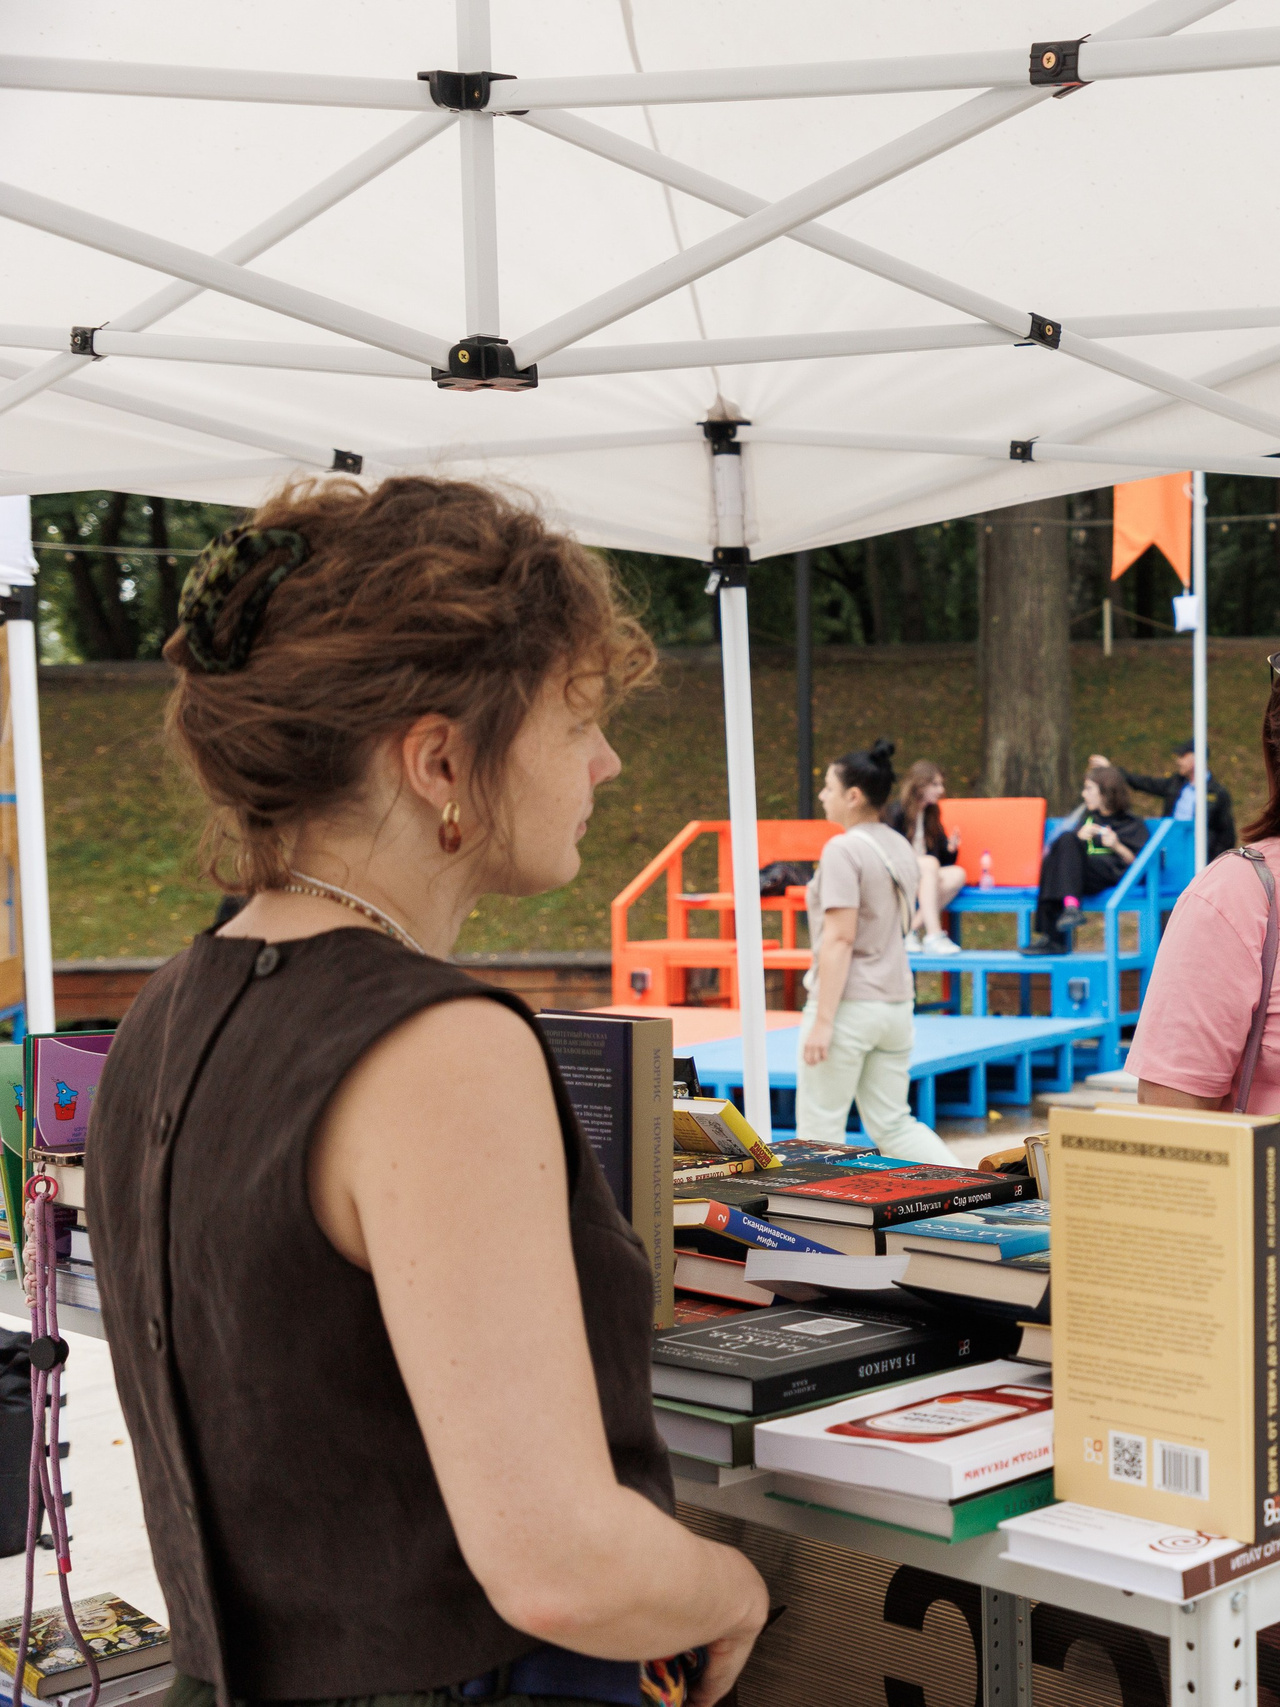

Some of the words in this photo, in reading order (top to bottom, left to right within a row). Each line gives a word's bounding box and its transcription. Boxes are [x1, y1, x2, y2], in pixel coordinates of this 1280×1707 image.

[653, 1048, 662, 1102] МОРРИС
[653, 1116, 662, 1216] НОРМАНДСКОЕ
[953, 1196, 967, 1207] Суд
[717, 1212, 727, 1223] 2
[742, 1215, 797, 1246] Скандинавские
[756, 1232, 779, 1249] мифы
[653, 1221, 663, 1307] ЗАВОЕВАНИЕ
[858, 1356, 903, 1379] БАНКОВ
[963, 1456, 1010, 1482] РЕКЛАМЫ
[1012, 1445, 1050, 1470] МЕТОДЫ
[1229, 1545, 1263, 1573] души
